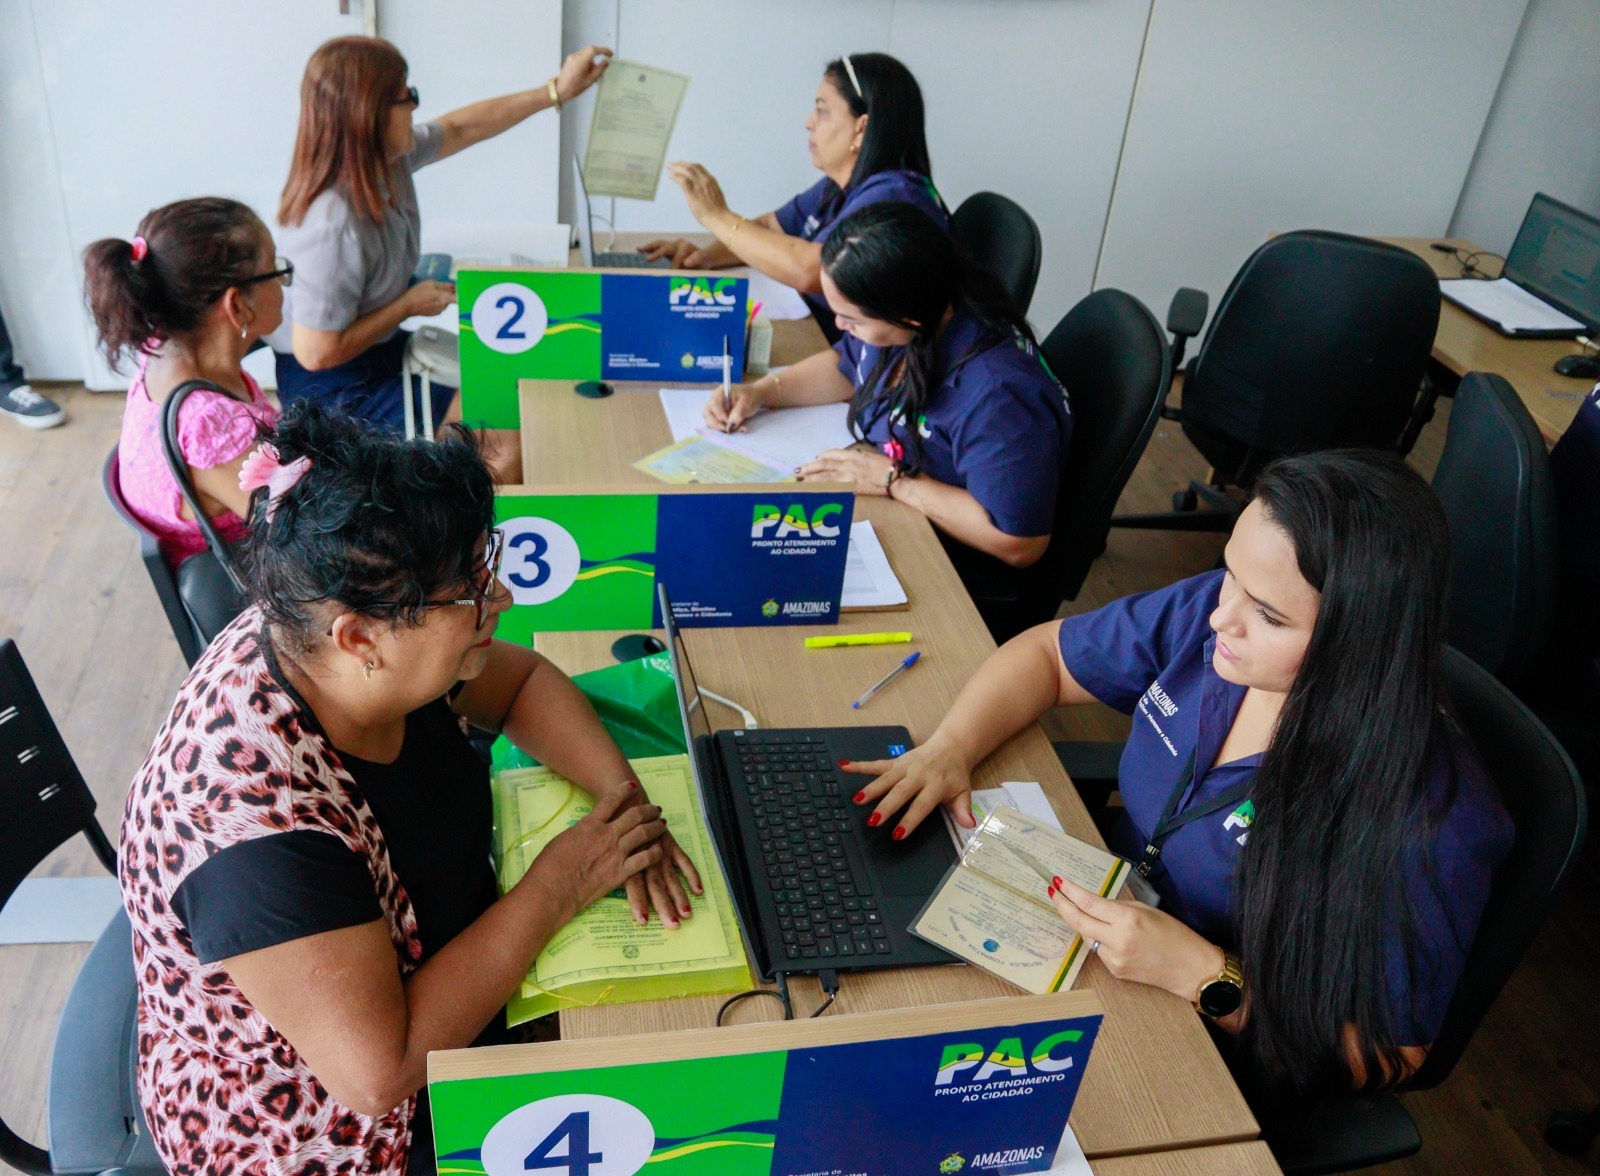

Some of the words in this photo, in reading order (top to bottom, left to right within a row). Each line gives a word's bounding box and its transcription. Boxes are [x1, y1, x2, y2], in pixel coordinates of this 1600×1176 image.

[669, 276, 737, 305] PAC
[496, 296, 526, 339] 2
[751, 503, 844, 538] PAC
[508, 532, 551, 588] 3
[782, 602, 830, 614] AMAZONAS
[935, 1030, 1084, 1085] PAC
[935, 1084, 982, 1096] PRONTO
[984, 1074, 1066, 1090] ATENDIMENTO
[962, 1094, 979, 1102] AO
[982, 1087, 1033, 1100] CIDADÃO
[524, 1111, 602, 1176] 4
[971, 1146, 1044, 1168] AMAZONAS
